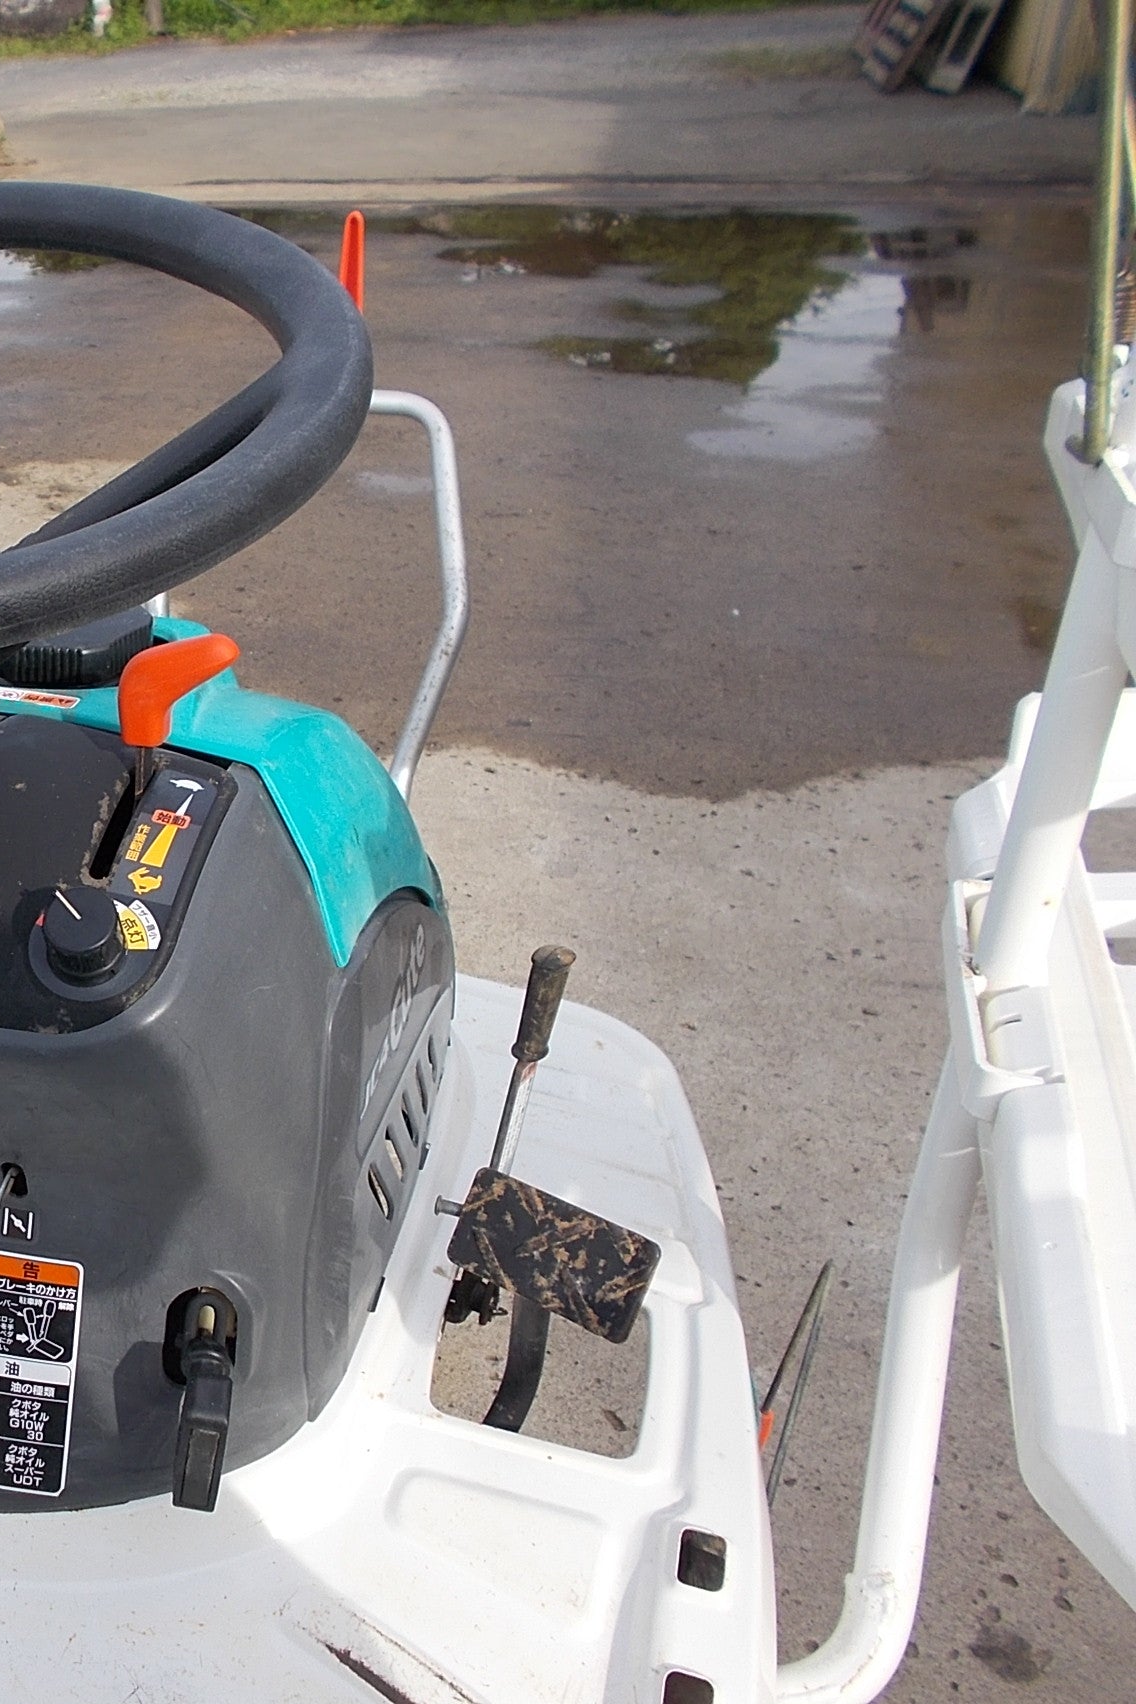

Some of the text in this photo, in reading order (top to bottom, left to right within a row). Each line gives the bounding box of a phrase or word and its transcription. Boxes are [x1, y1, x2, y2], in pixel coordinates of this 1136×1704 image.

[155, 811, 186, 827] 始動
[120, 917, 145, 944] 点灯
[10, 1382, 55, 1397] 油の種類
[11, 1398, 41, 1411] クボタ
[9, 1408, 50, 1422] 純オイル
[10, 1418, 45, 1431] G10W
[26, 1430, 43, 1441] 30
[7, 1444, 38, 1456] クボタ
[5, 1454, 45, 1468] 純オイル
[5, 1463, 45, 1476] スーパー
[13, 1474, 43, 1487] UDT
